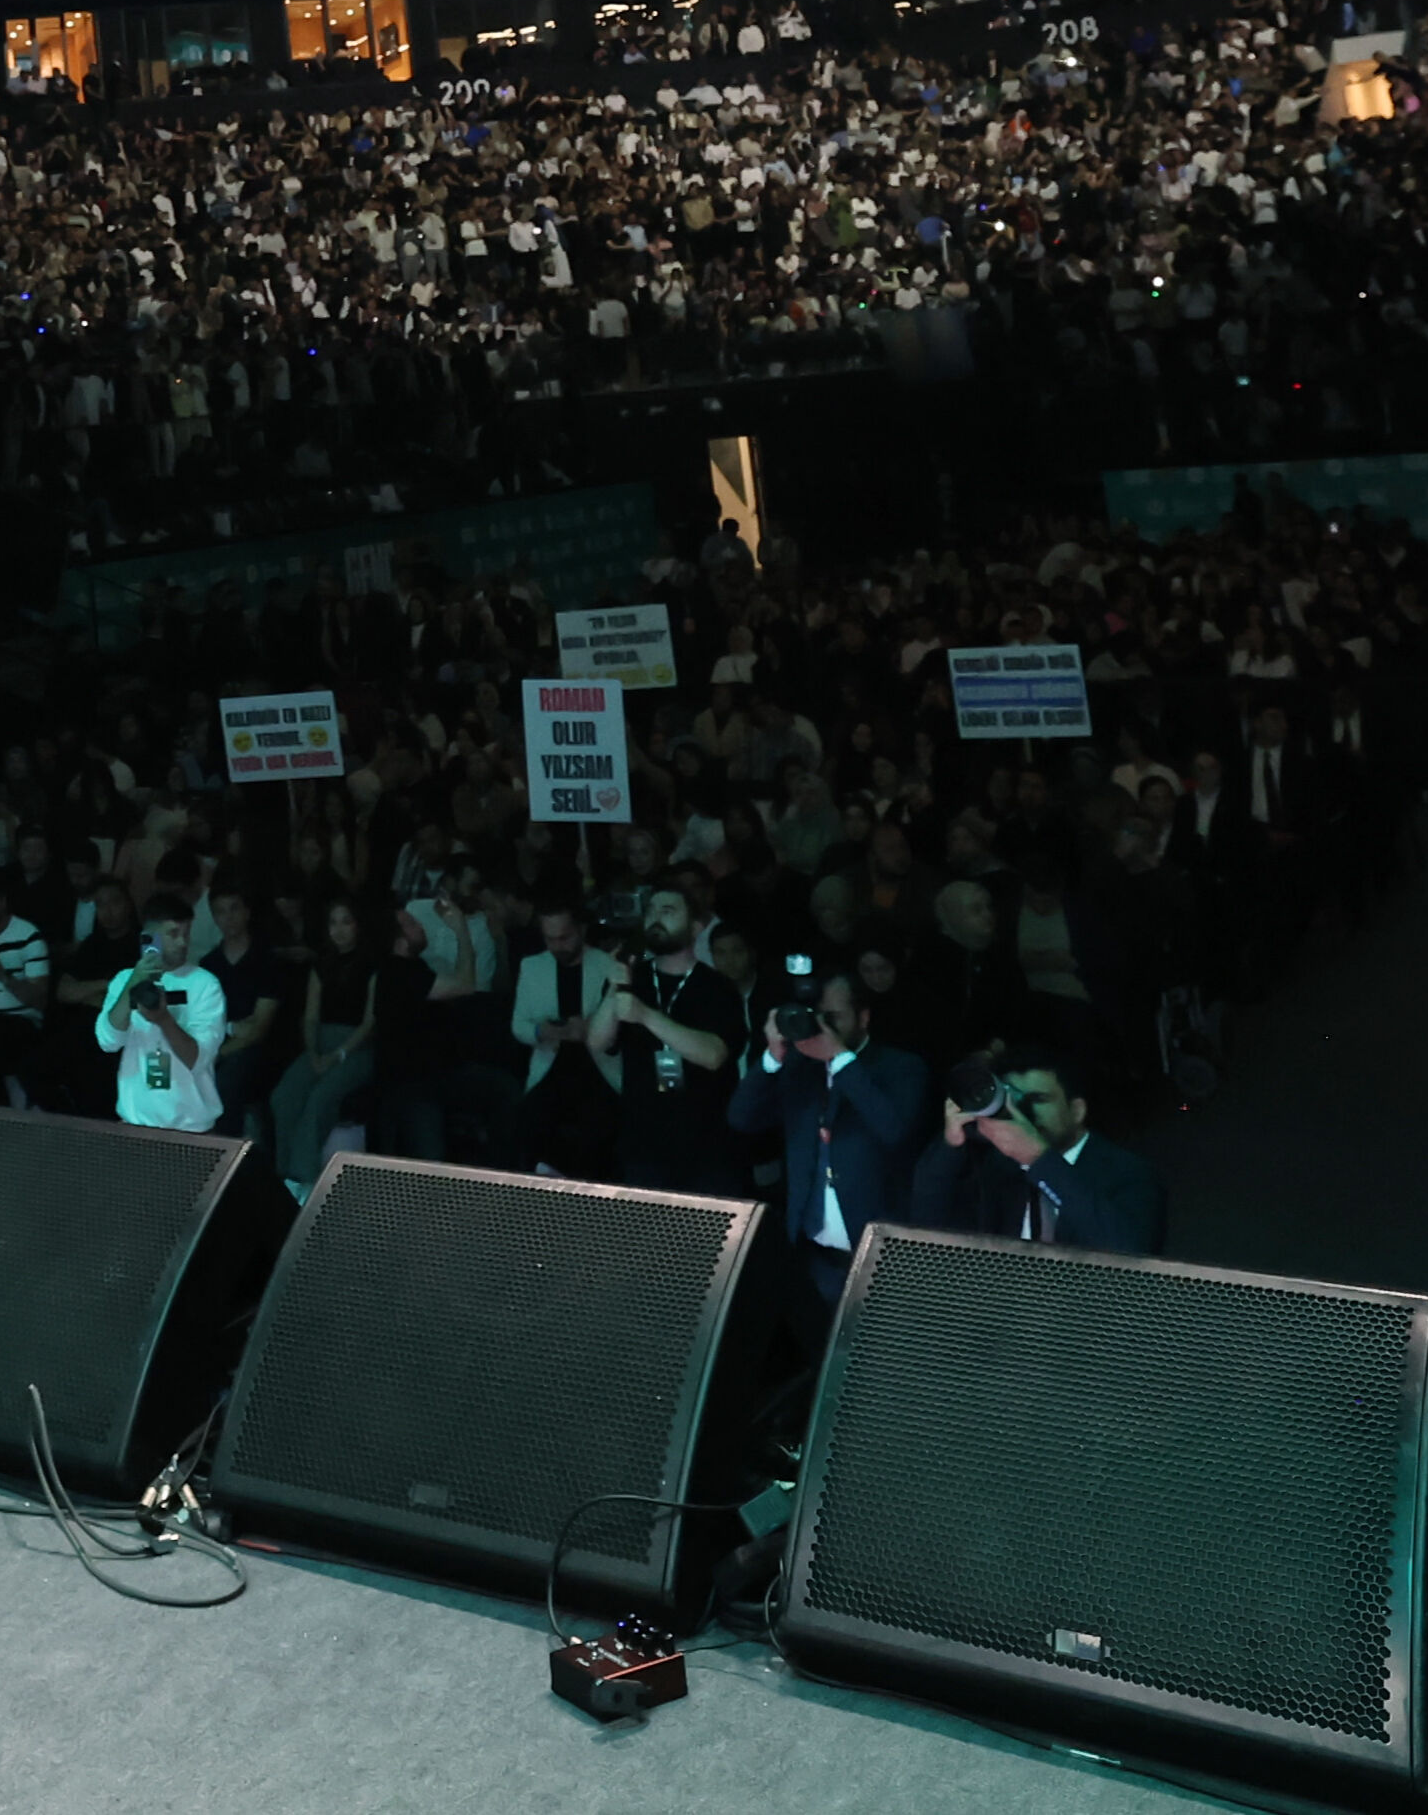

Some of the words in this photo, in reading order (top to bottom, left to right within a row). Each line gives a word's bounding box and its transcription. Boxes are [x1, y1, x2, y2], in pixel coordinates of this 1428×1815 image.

[540, 688, 605, 711] ROMAN
[553, 721, 596, 745] OLUR
[542, 755, 613, 779] YAZSAM
